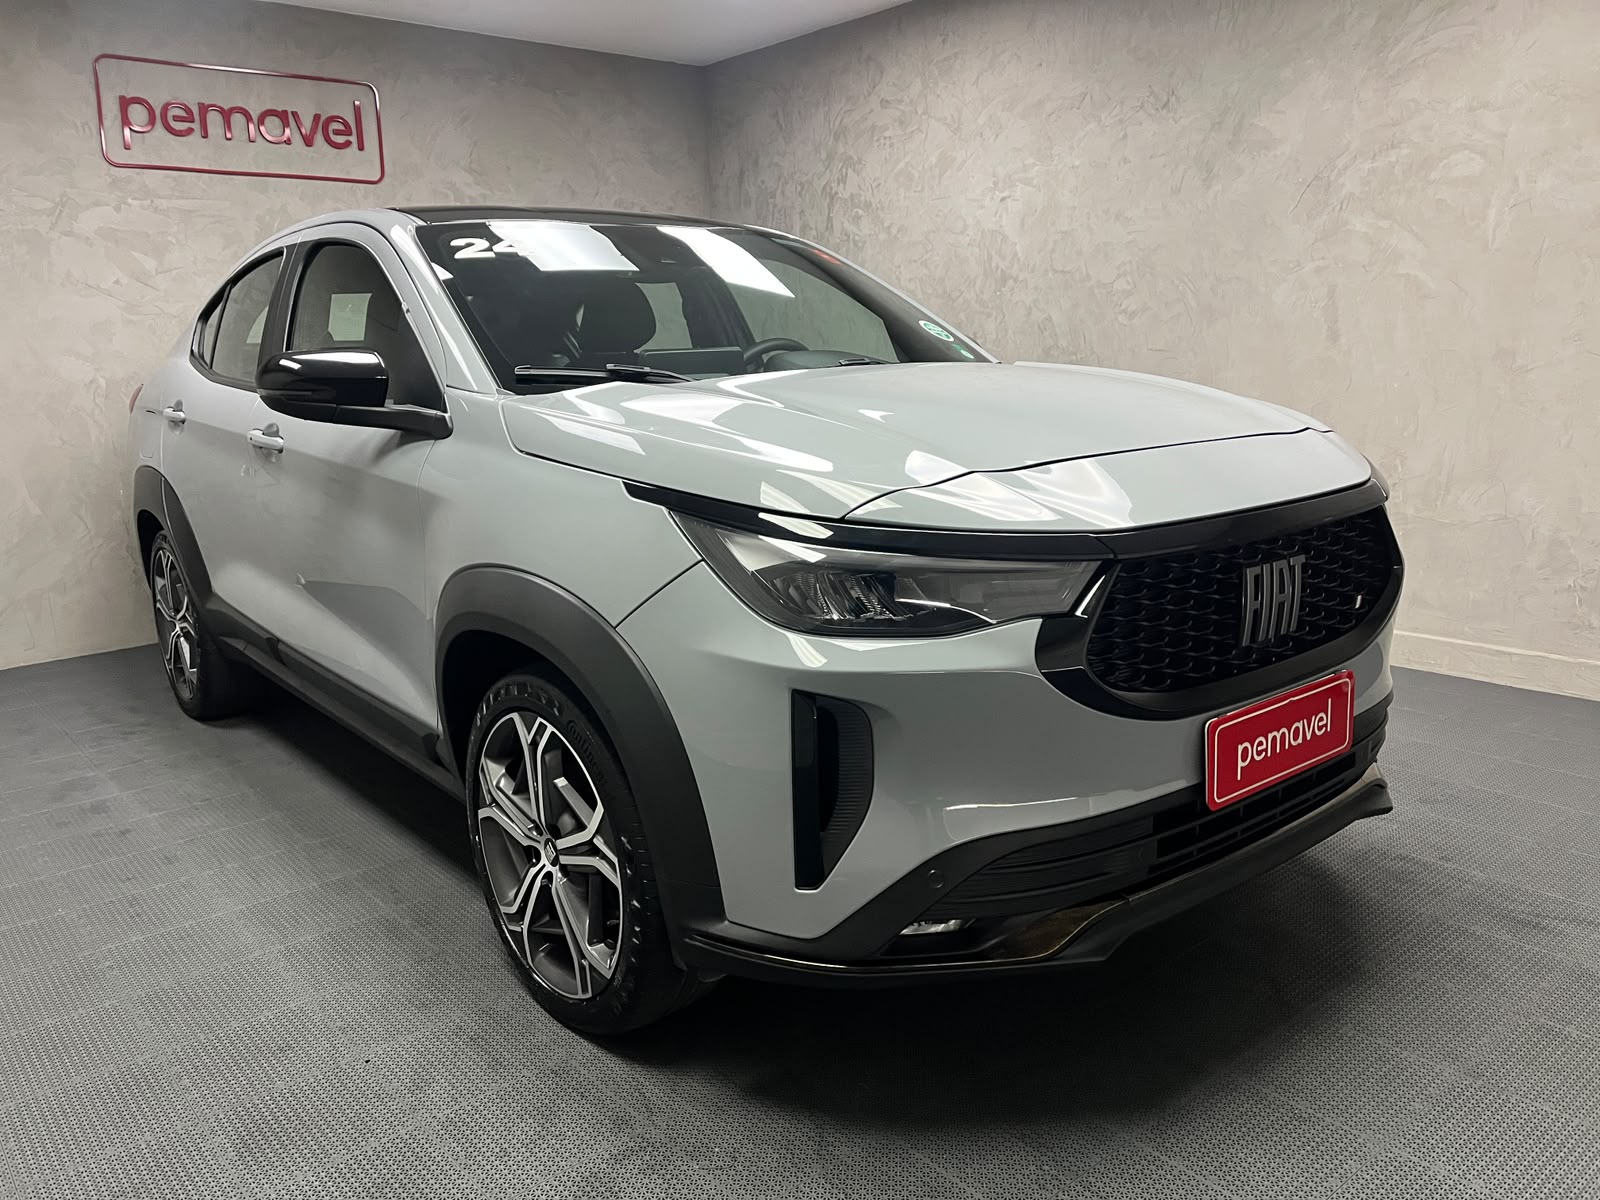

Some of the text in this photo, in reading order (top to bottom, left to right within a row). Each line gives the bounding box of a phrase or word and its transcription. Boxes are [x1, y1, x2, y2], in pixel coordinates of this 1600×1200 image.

[118, 94, 365, 151] pemavel
[1242, 554, 1306, 647] FIAT
[1236, 697, 1332, 781] pemavel
